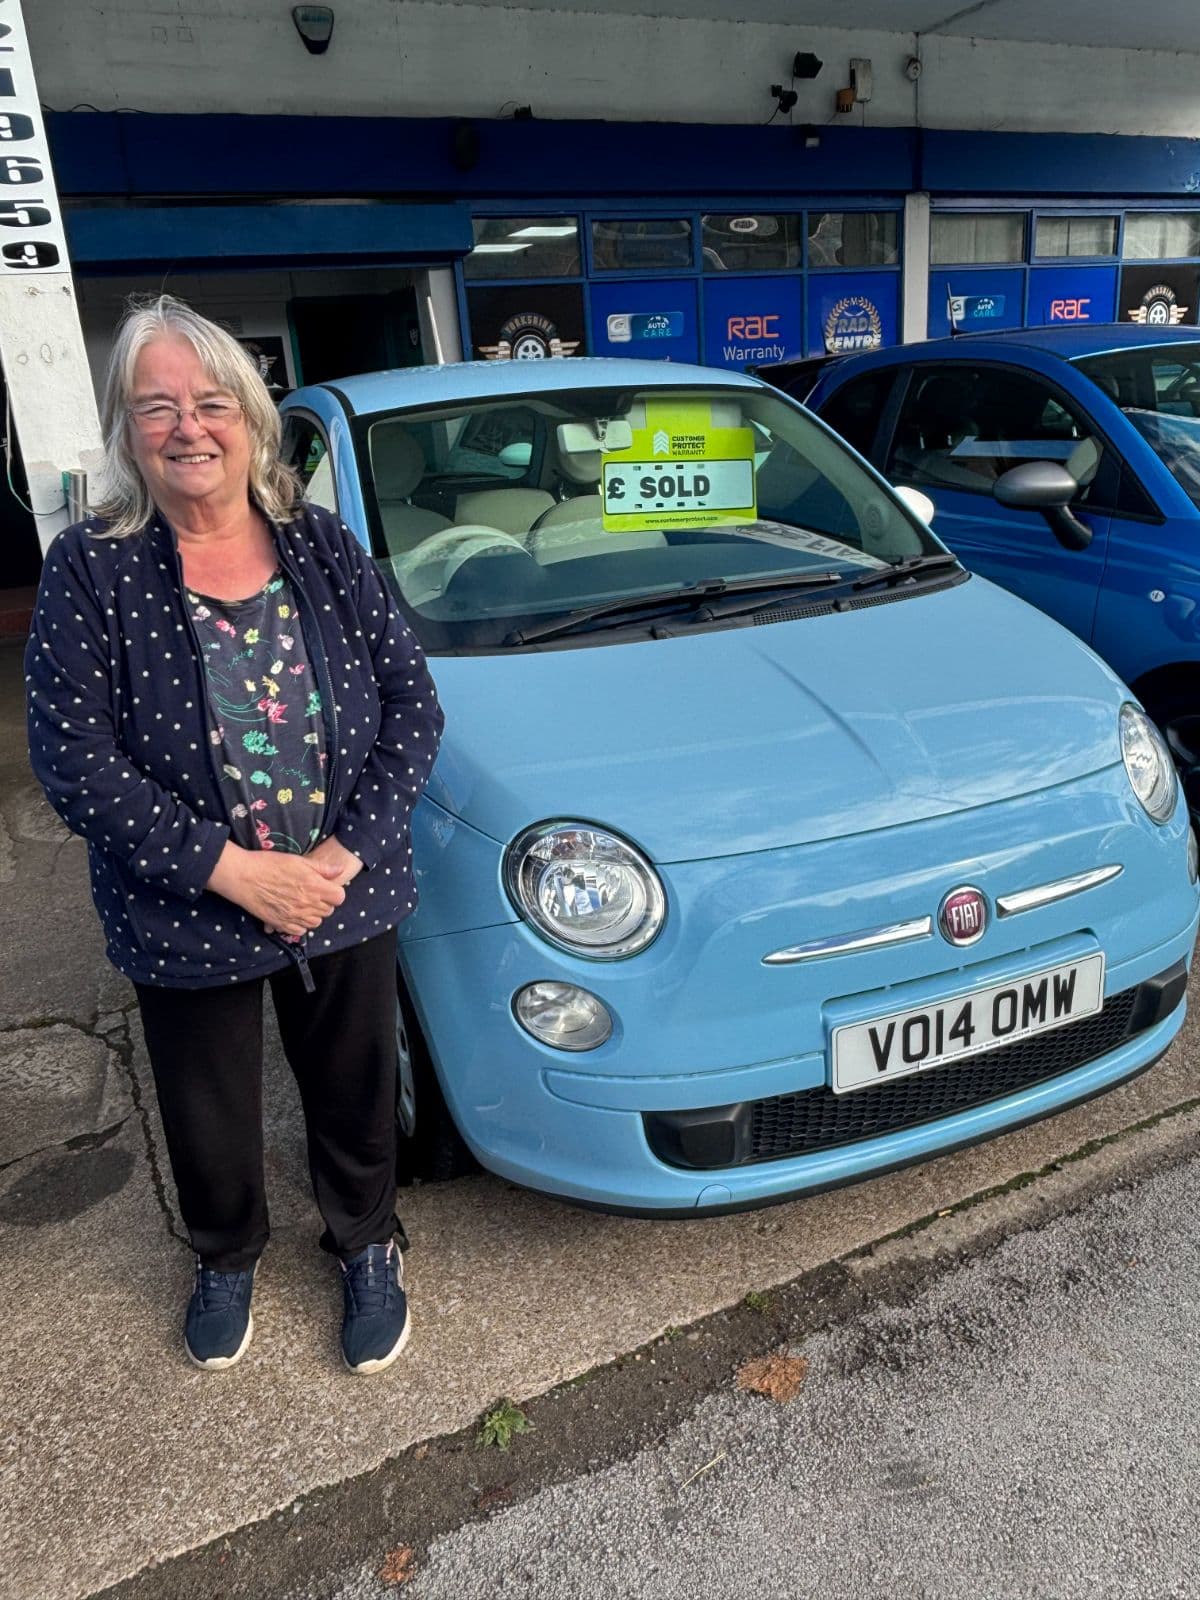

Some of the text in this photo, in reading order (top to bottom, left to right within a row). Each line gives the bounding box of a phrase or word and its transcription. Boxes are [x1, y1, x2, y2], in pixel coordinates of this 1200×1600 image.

[643, 328, 672, 338] CARE
[723, 345, 785, 361] Warranty
[672, 442, 706, 450] PROTECT
[672, 449, 706, 457] WARRANTY
[607, 475, 710, 499] £ SOLD
[950, 902, 979, 932] FIAT
[868, 1000, 975, 1073] VO14
[992, 968, 1077, 1038] OMW
